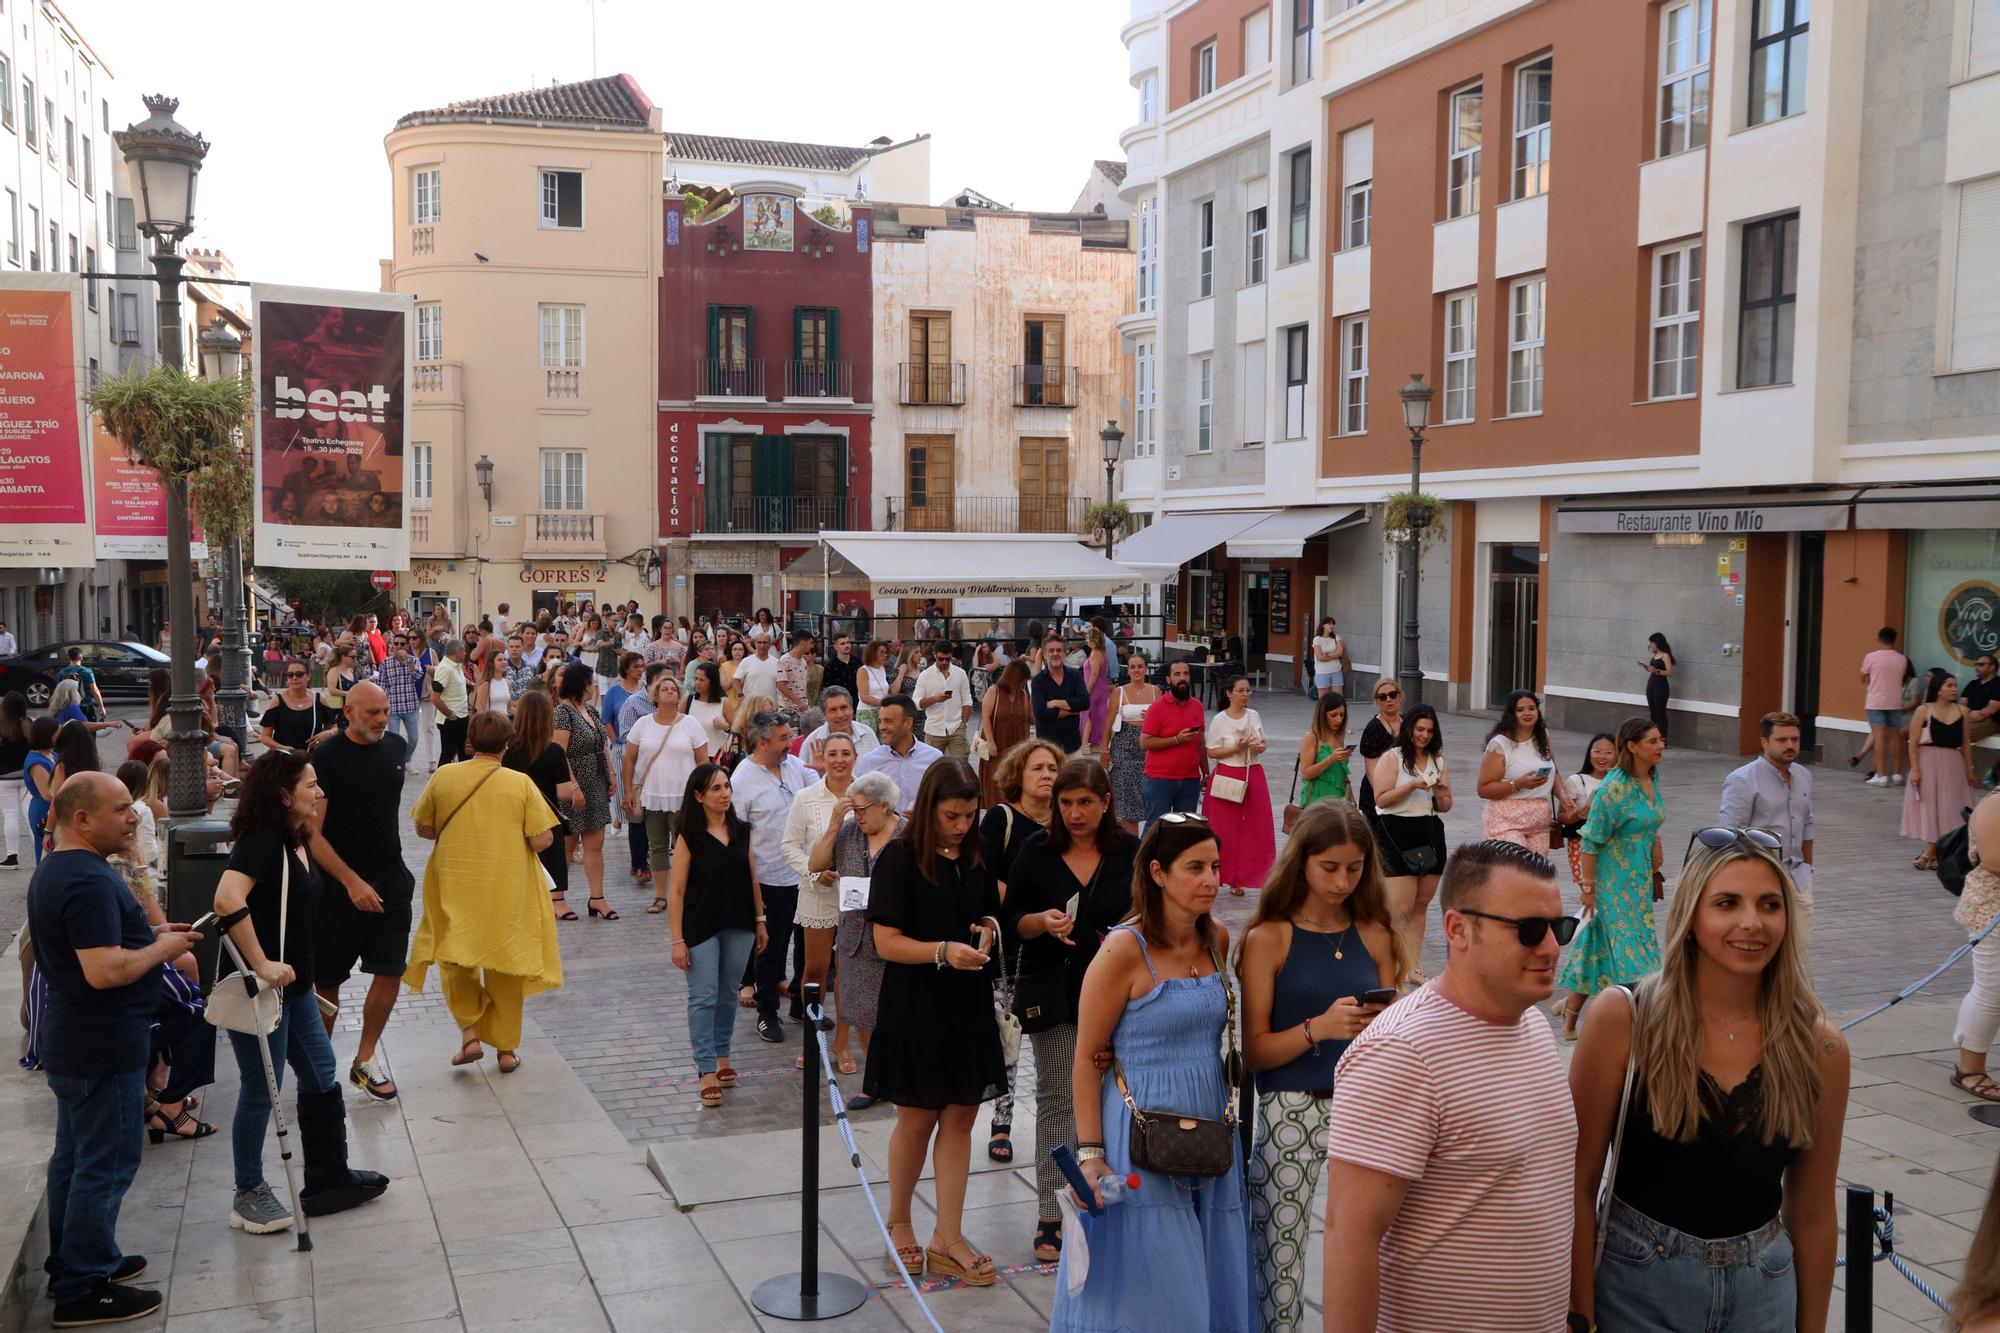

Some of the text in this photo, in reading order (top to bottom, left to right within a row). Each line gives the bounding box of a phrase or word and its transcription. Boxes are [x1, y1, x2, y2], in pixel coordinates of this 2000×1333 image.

[275, 376, 390, 423] beat
[35, 419, 59, 428] TRÍO
[326, 438, 364, 447] Echegaray
[670, 423, 679, 526] decoración
[1617, 510, 1764, 531] Restaurante Vino Mío
[596, 569, 606, 582] 2
[878, 586, 908, 595] Cocina
[910, 586, 957, 595] Mexicana
[959, 588, 966, 596] y
[1055, 584, 1066, 593] Bar
